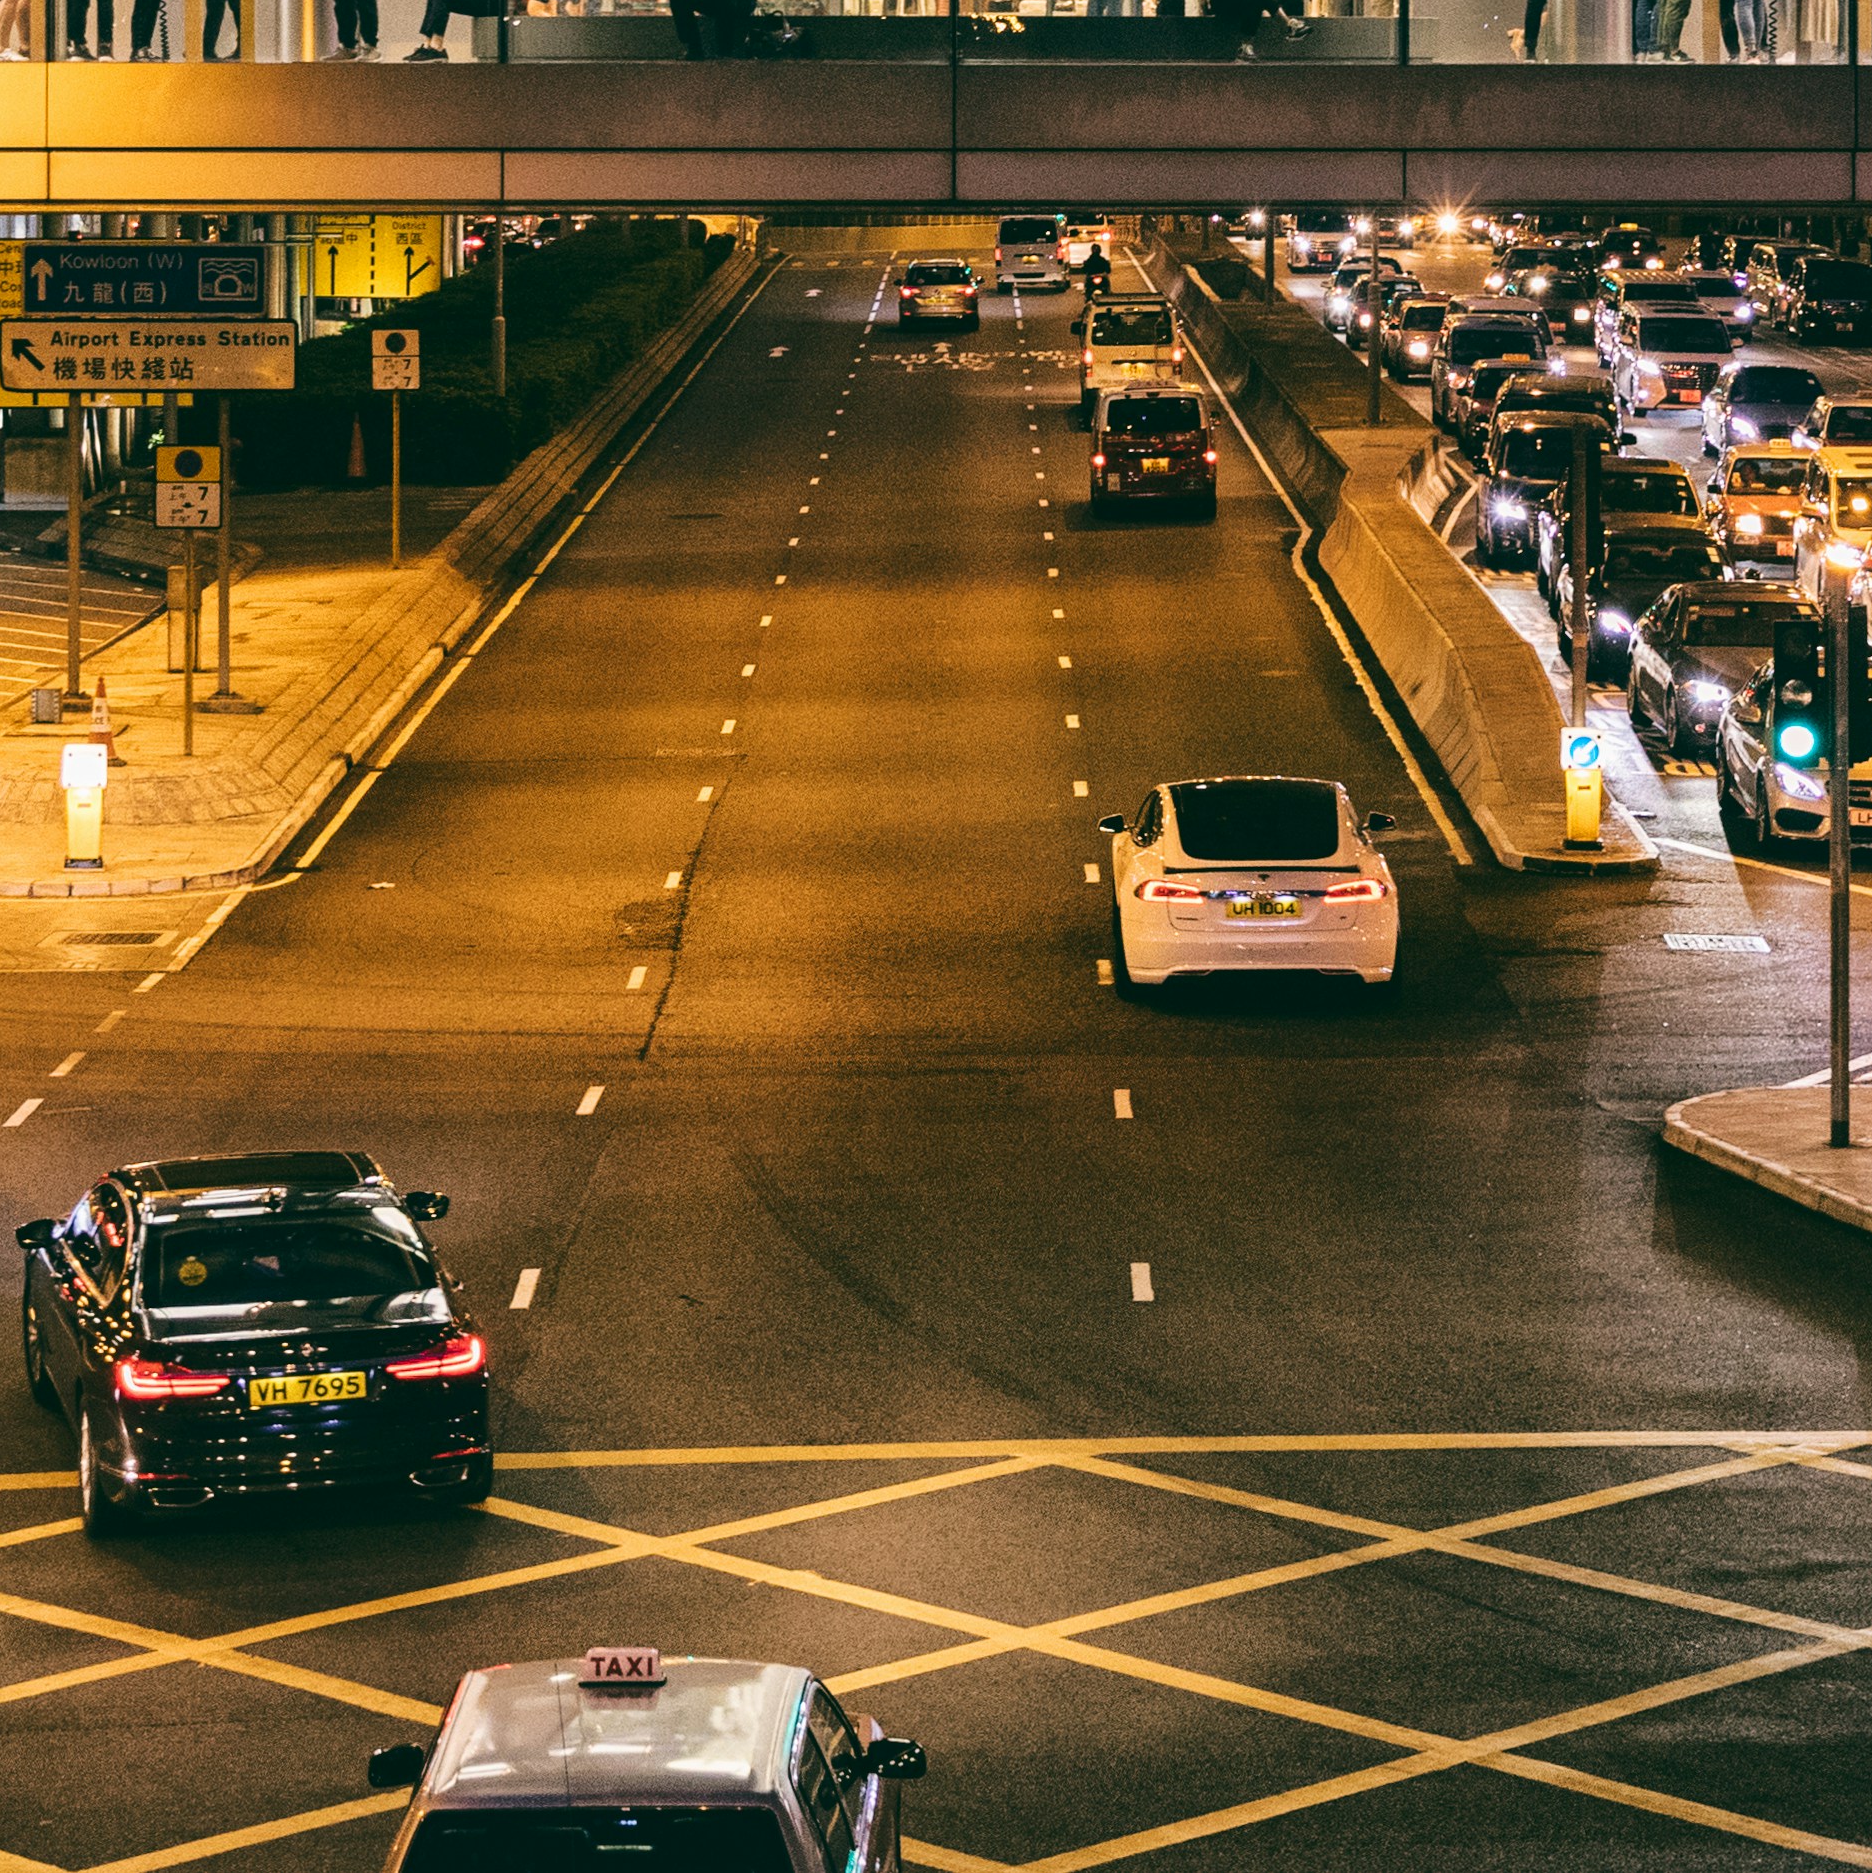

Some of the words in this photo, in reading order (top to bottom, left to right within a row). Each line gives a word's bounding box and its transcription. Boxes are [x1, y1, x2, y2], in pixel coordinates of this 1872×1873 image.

[391, 221, 427, 230] District
[59, 253, 139, 269] Kowloon
[147, 252, 184, 270] (W)
[51, 330, 120, 350] Airport
[129, 330, 207, 350] Express
[217, 330, 290, 347] Station
[402, 359, 412, 371] 7
[402, 376, 412, 388] 7
[197, 486, 208, 501] 7
[197, 509, 208, 524] 7
[1232, 903, 1255, 915] UH
[1258, 902, 1296, 915] 1004
[255, 1381, 288, 1402] VH
[298, 1375, 361, 1398] 7695
[589, 1656, 653, 1678] TAXI
